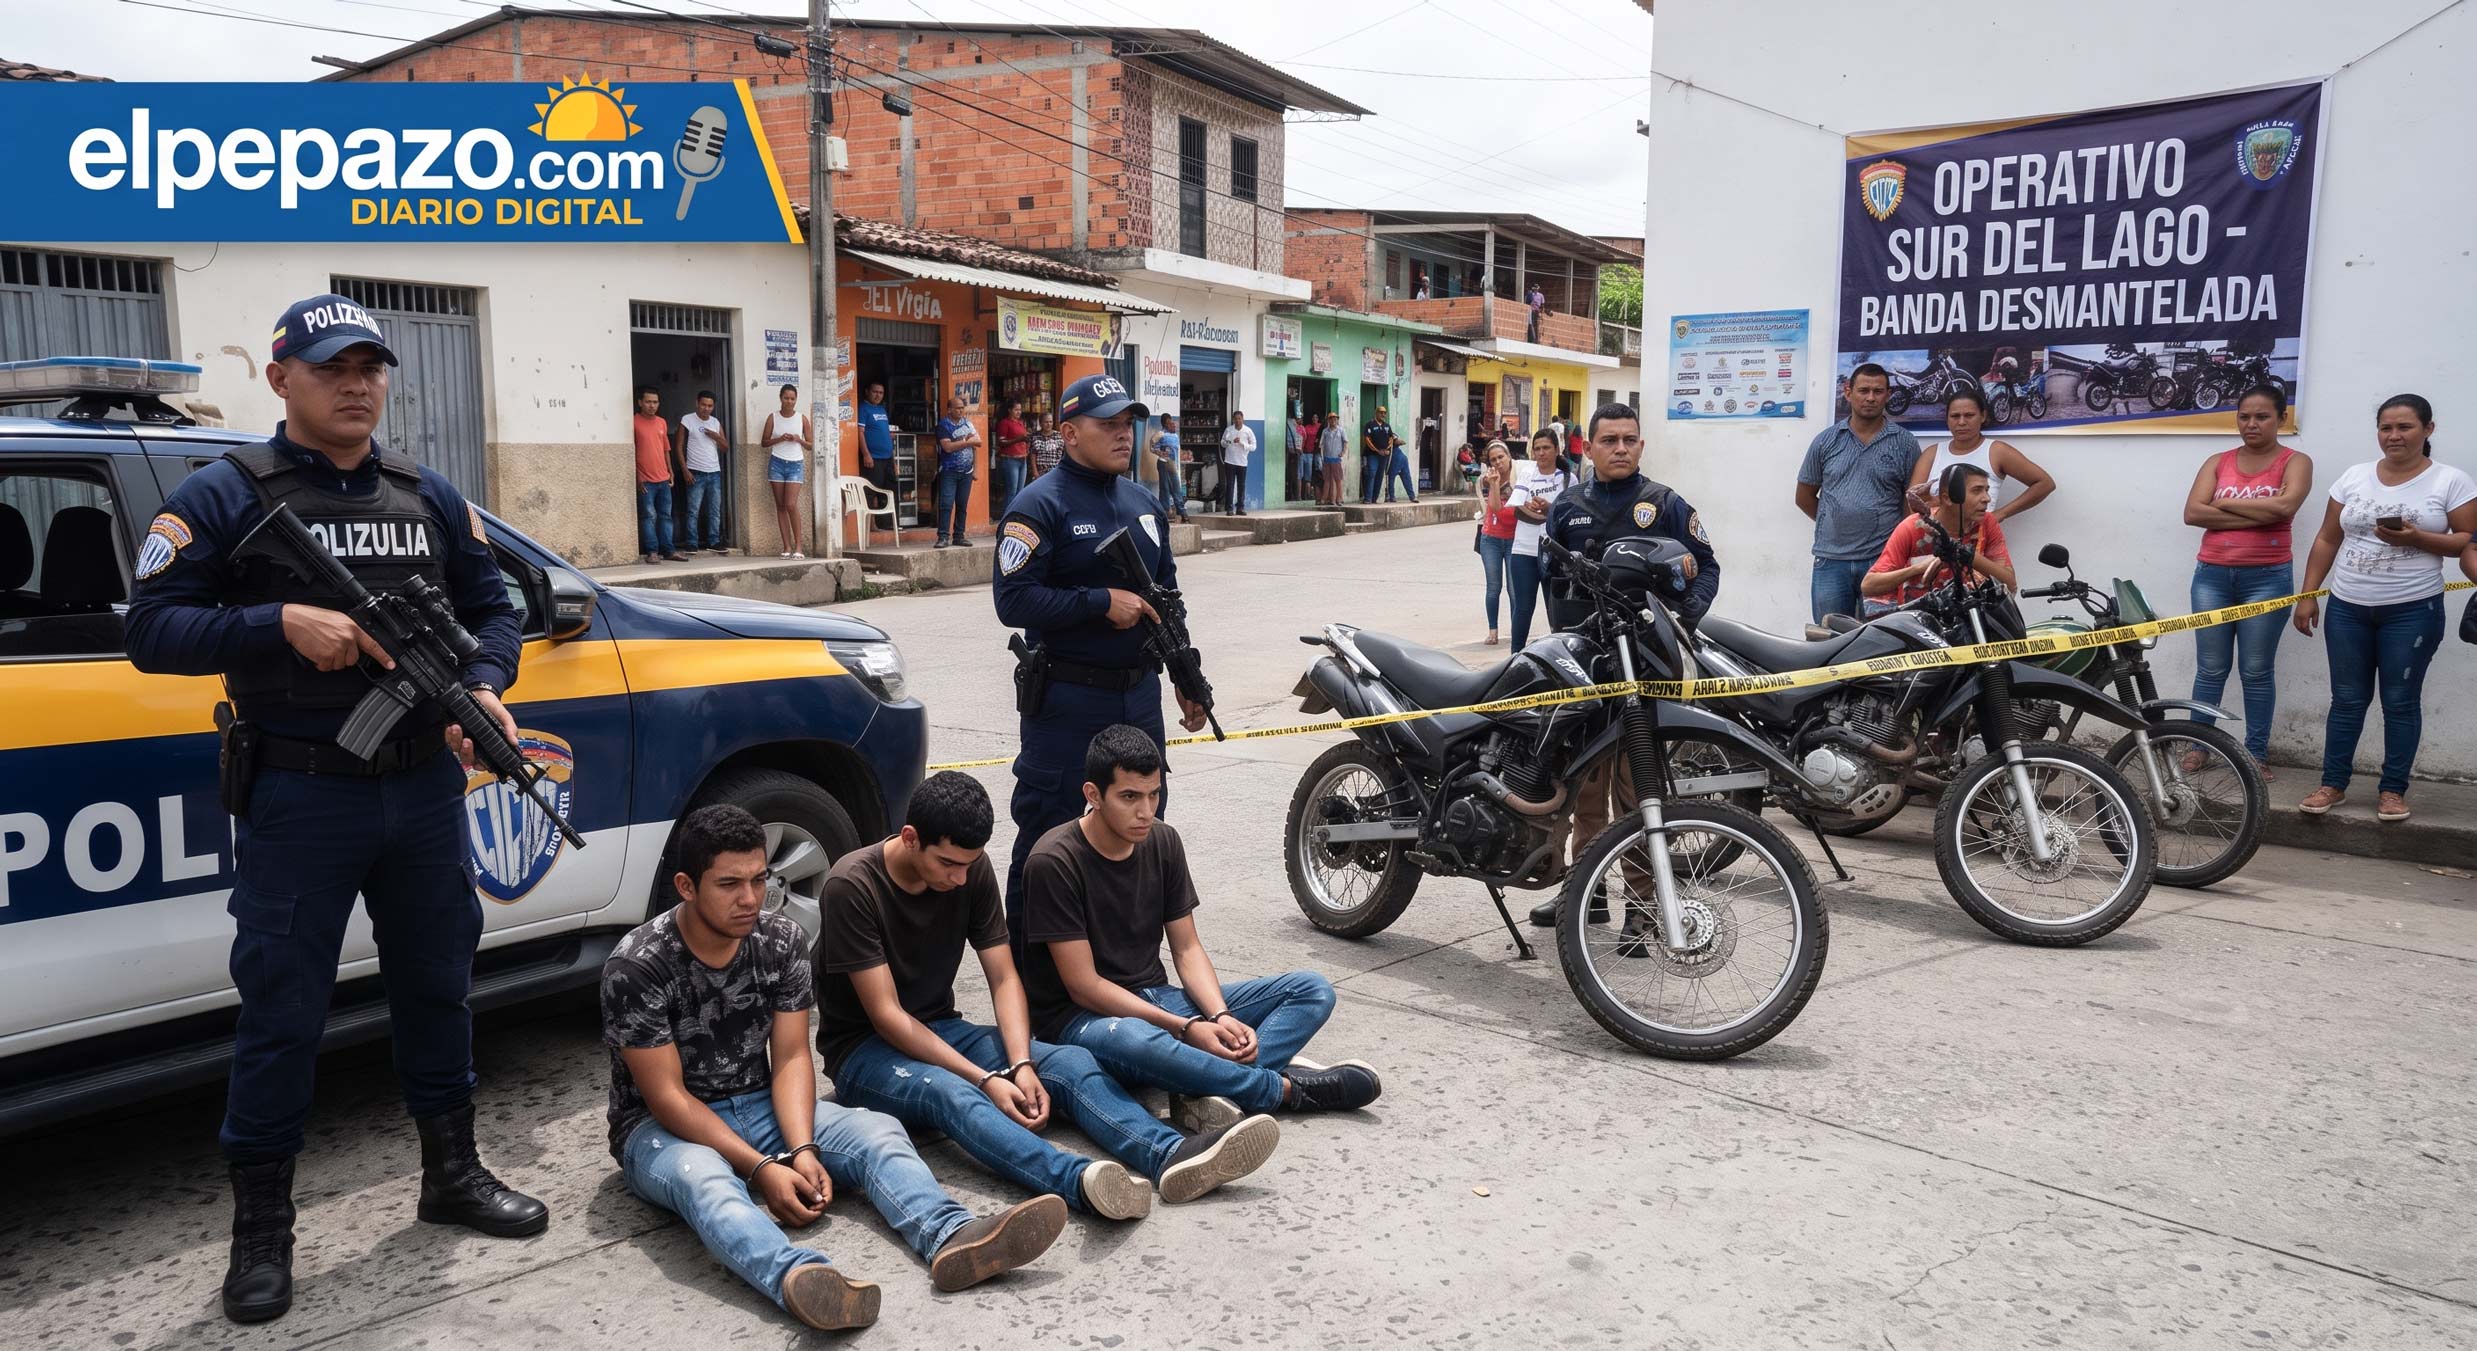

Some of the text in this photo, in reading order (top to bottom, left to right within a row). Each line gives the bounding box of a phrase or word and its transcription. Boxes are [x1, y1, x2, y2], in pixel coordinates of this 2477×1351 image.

[1933, 137, 2187, 216] OPERATIVO
[1886, 223, 1969, 283] SUR
[1983, 216, 2067, 277] DEL
[2081, 204, 2210, 271] LAGO
[1859, 290, 1968, 337] BANDA
[1977, 273, 2279, 333] DESMANTELADA
[304, 522, 431, 557] OLIZULIA
[0, 794, 237, 908] POL
